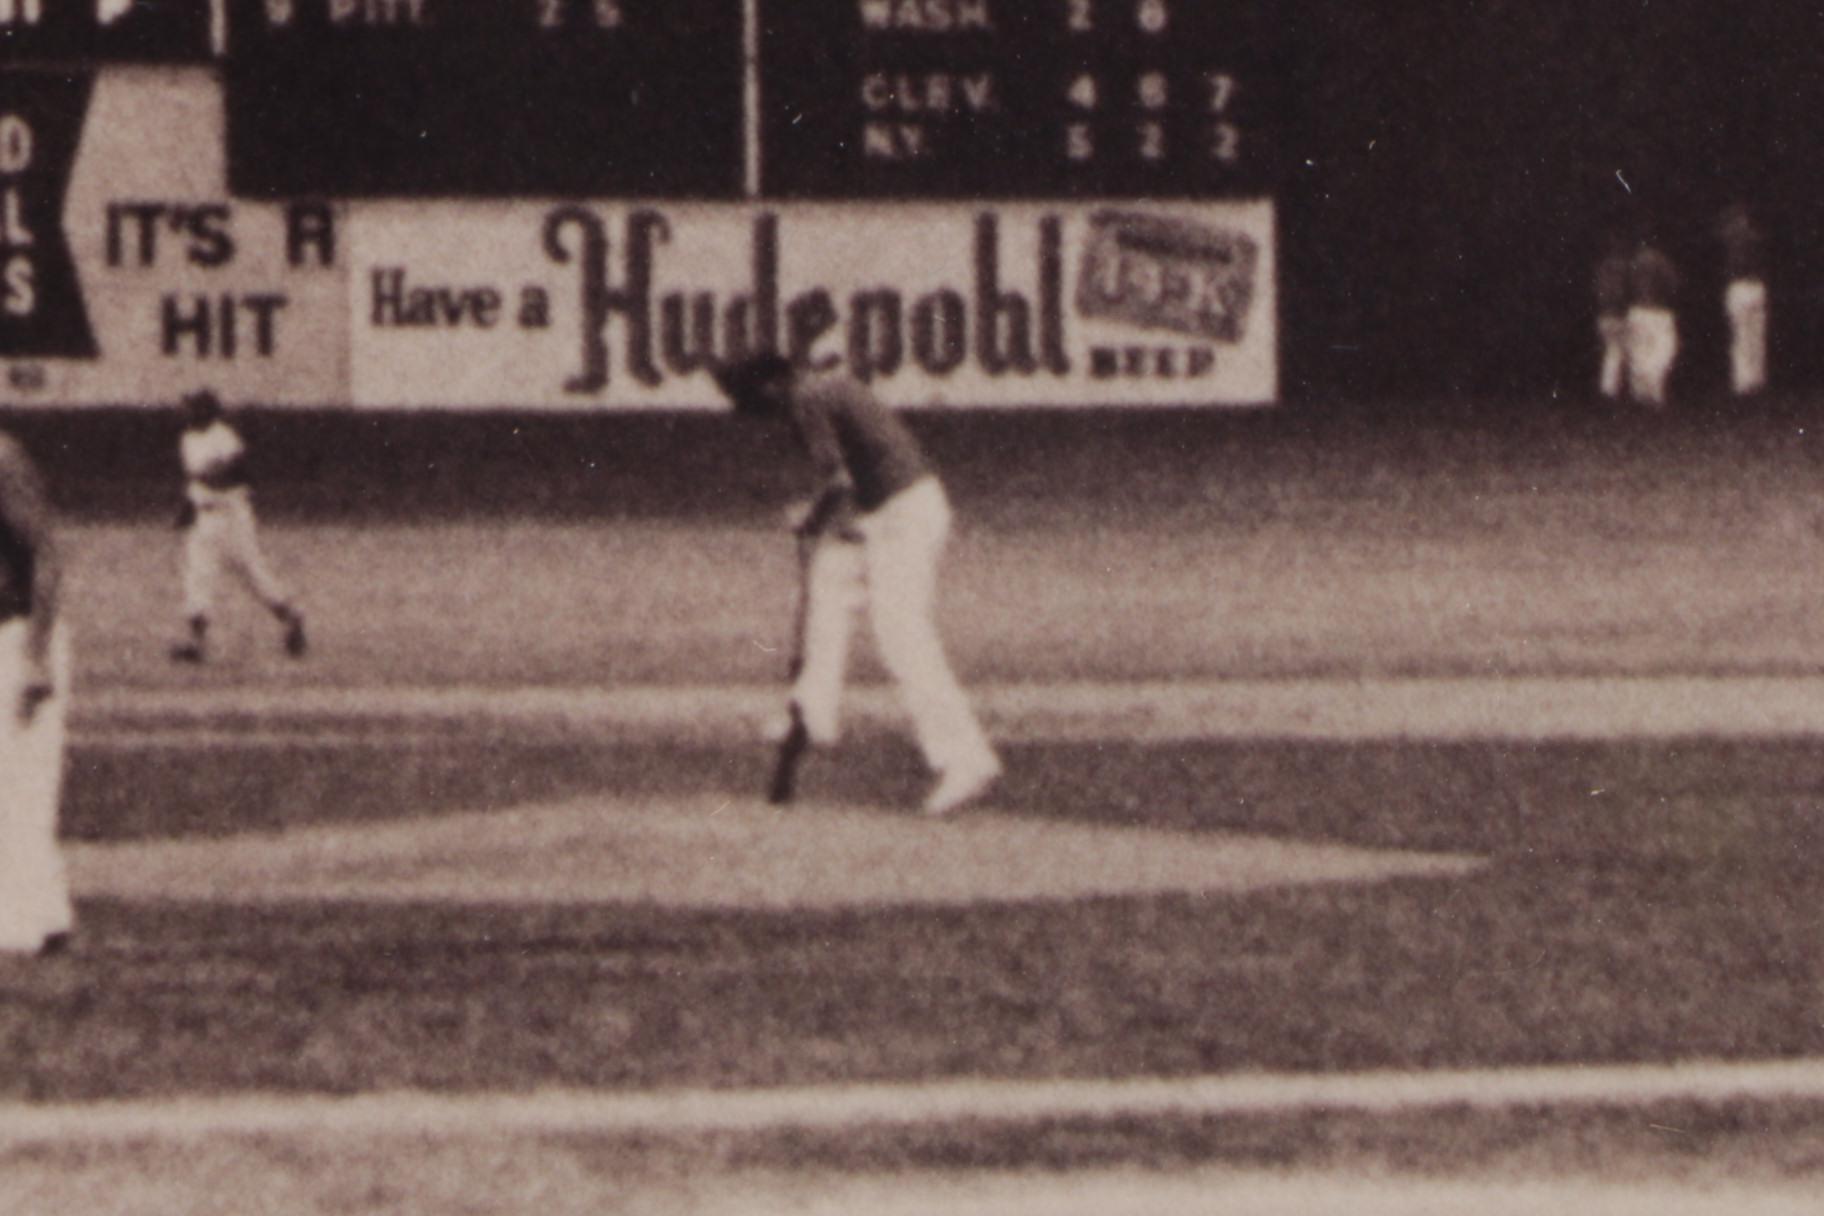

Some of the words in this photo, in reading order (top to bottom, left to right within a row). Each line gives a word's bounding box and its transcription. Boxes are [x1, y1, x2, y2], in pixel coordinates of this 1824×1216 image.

[1066, 73, 1096, 110] 4
[1208, 73, 1236, 112] 7
[106, 203, 236, 268] IT'S
[160, 295, 286, 358] HIT
[370, 267, 501, 328] Have
[516, 288, 551, 328] a
[542, 206, 1071, 393] Hudepohl
